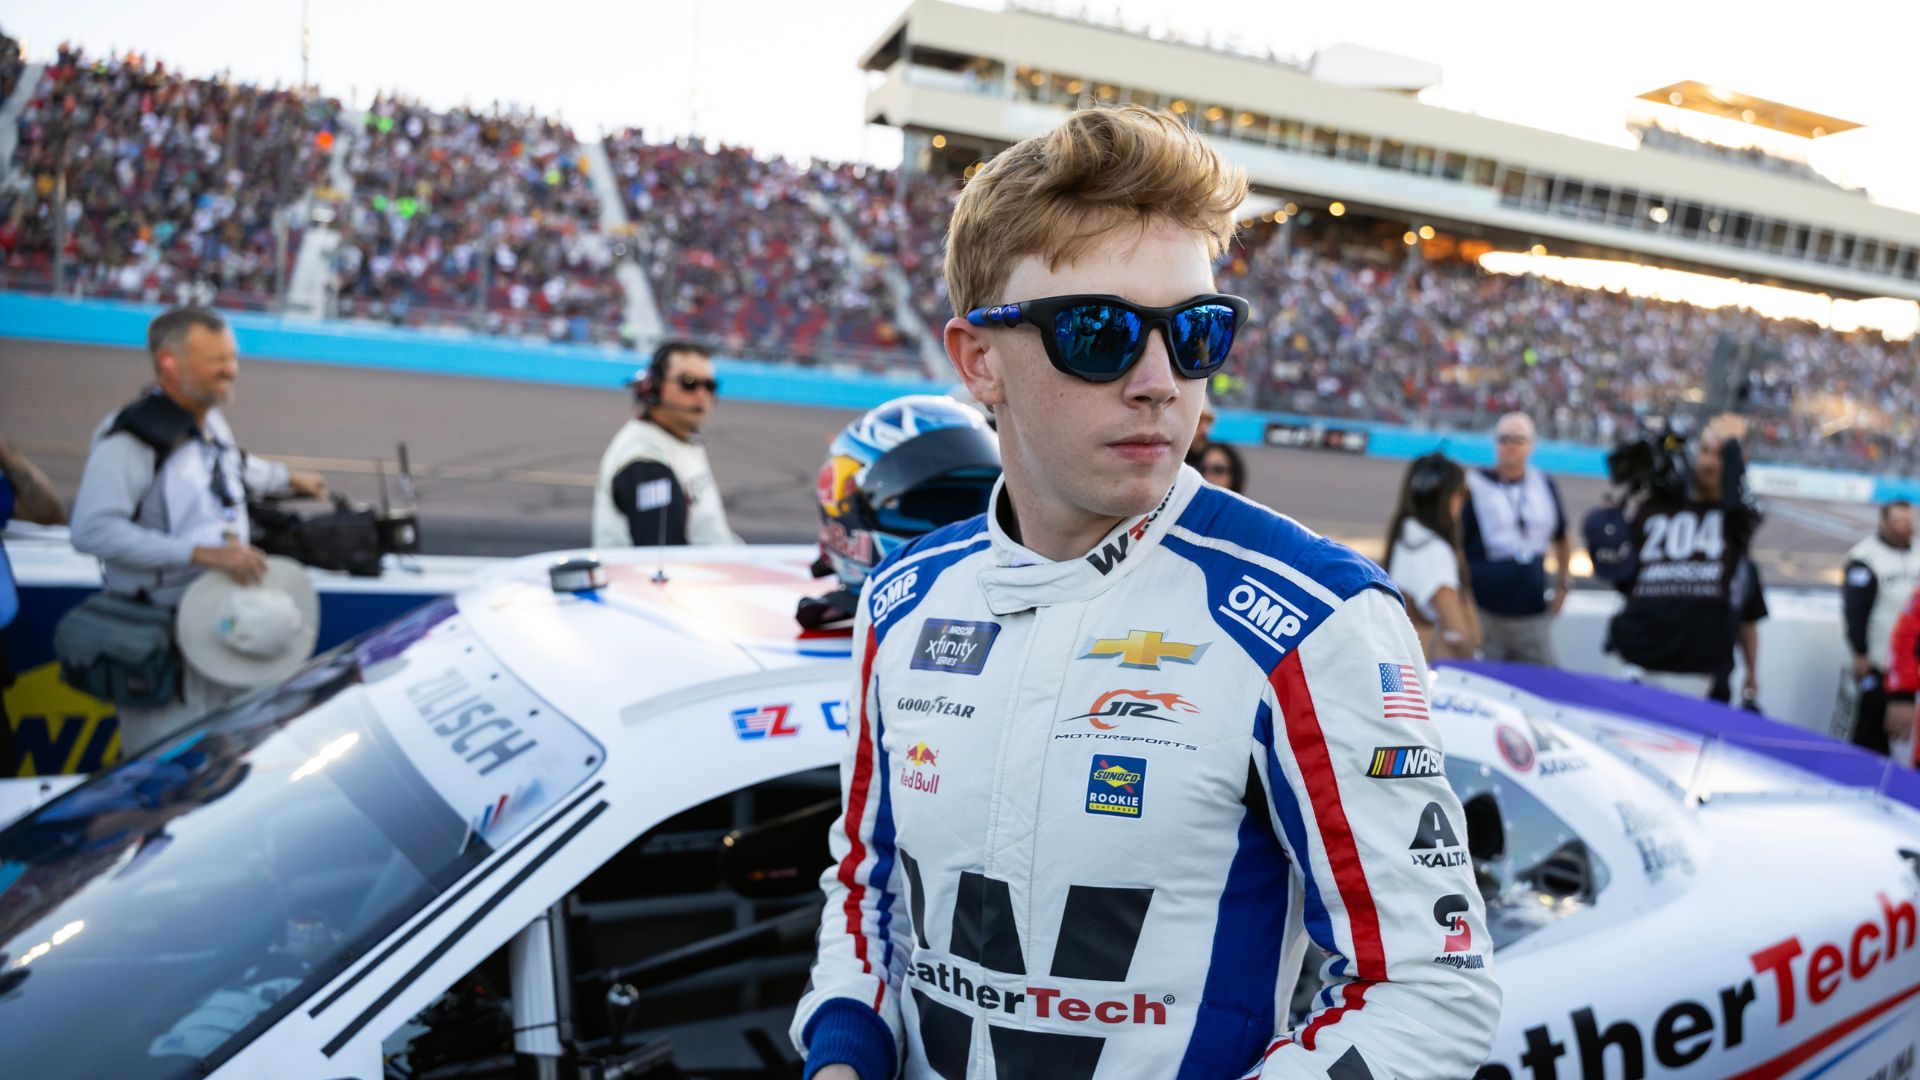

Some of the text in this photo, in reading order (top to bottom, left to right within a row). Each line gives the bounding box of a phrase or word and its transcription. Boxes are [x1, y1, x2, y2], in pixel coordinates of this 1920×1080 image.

[1639, 510, 1726, 561] 204
[873, 572, 918, 618] OMP
[1228, 584, 1301, 639] OMP
[925, 635, 978, 662] xfinity
[936, 656, 957, 666] SERIES
[1055, 733, 1198, 751] MOTORSPORTS
[914, 771, 940, 794] Bull
[1096, 770, 1139, 784] SUNOCO
[1089, 792, 1139, 806] ROOKIE
[1090, 803, 1137, 814] CONTENDER
[1412, 852, 1468, 868] AXALTA
[1472, 888, 1917, 1080] therTech
